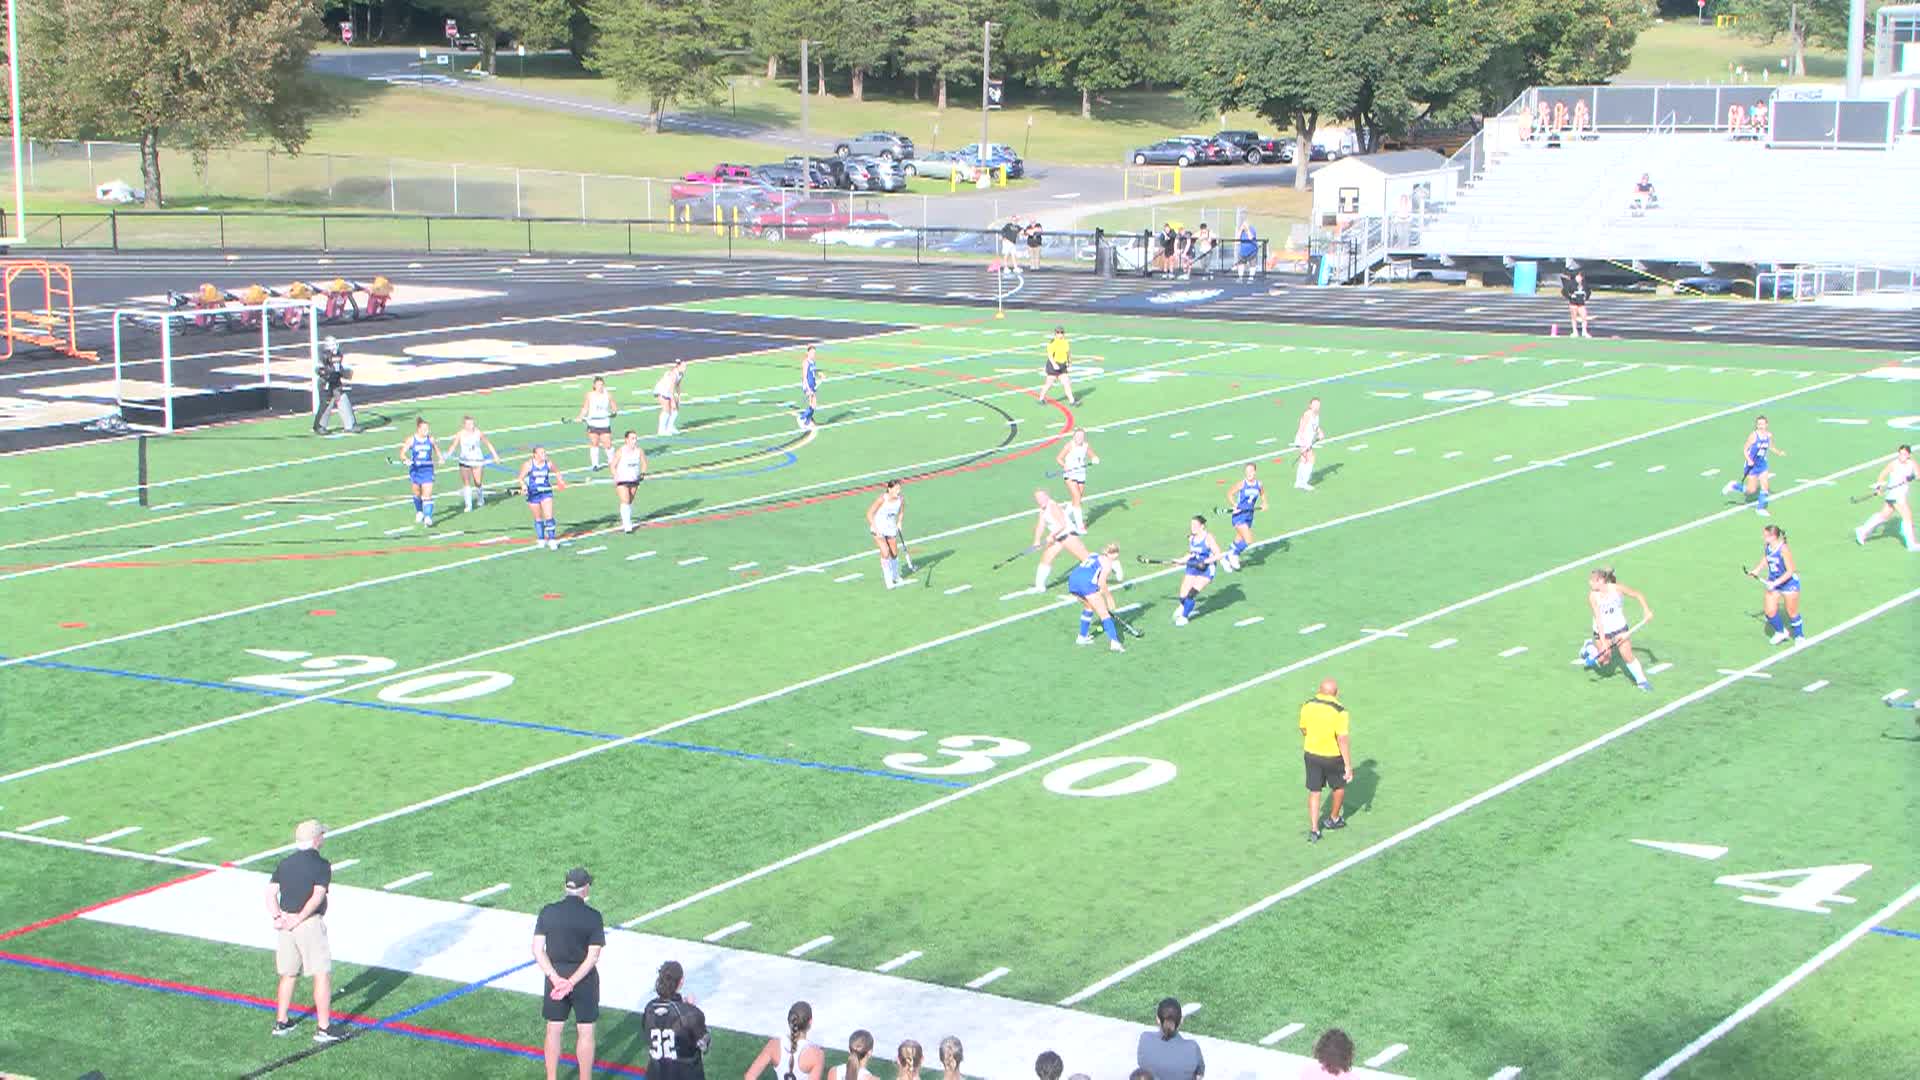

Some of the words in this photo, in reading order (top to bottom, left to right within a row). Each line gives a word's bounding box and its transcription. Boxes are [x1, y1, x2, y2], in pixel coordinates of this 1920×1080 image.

[882, 735, 1177, 797] 30
[1713, 863, 1873, 914] 4
[649, 1028, 677, 1060] 32
